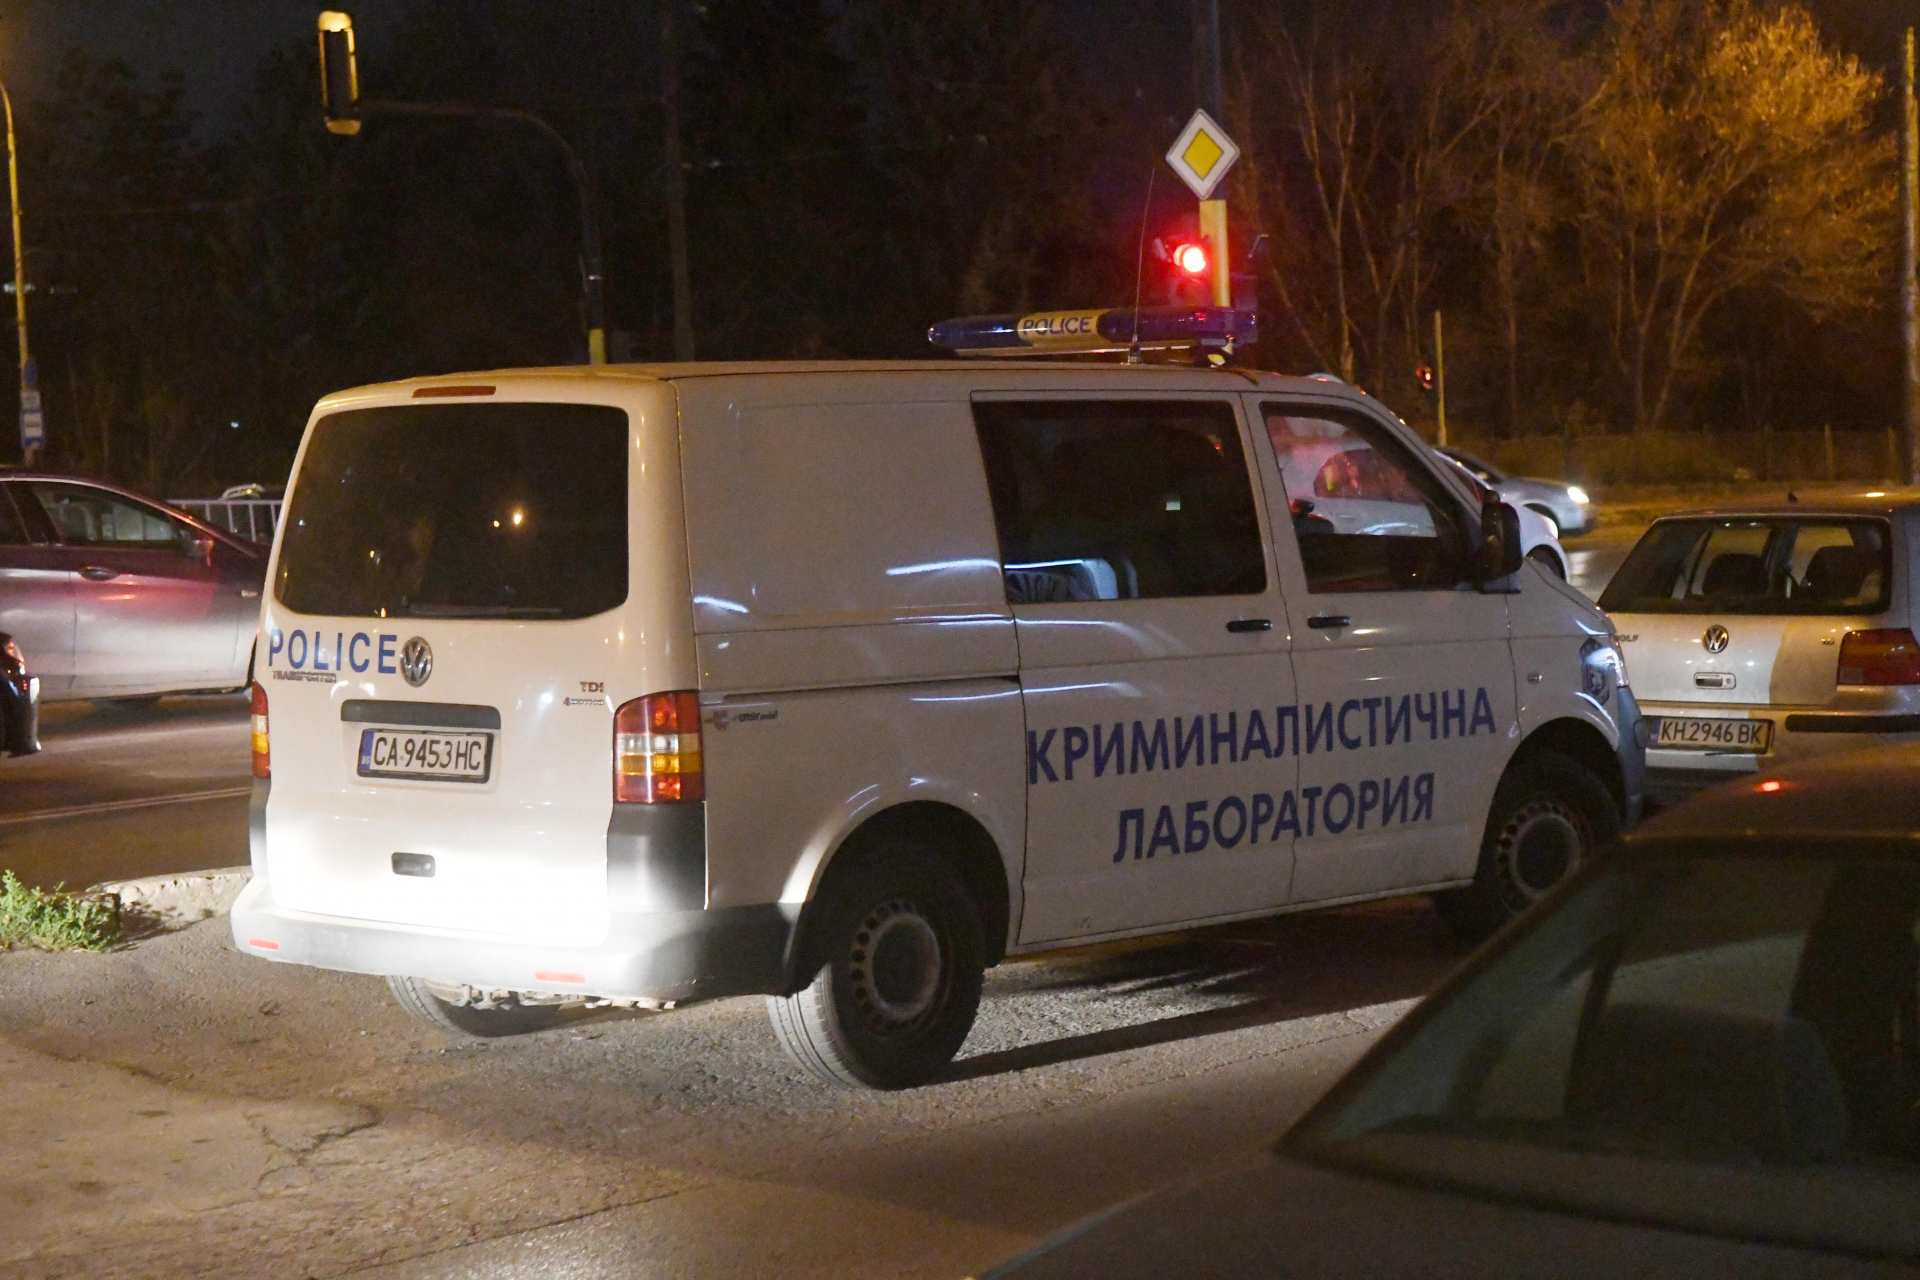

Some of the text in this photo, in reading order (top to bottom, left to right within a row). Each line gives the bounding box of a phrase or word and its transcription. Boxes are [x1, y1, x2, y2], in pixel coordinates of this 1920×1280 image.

[1023, 317, 1093, 335] POLICE
[269, 629, 397, 674] POLICE
[580, 681, 604, 693] TDI
[1028, 687, 1496, 785] КРИМИНАЛИСТИЧНА
[1112, 772, 1435, 863] ЛАБОРАТОРИЯ
